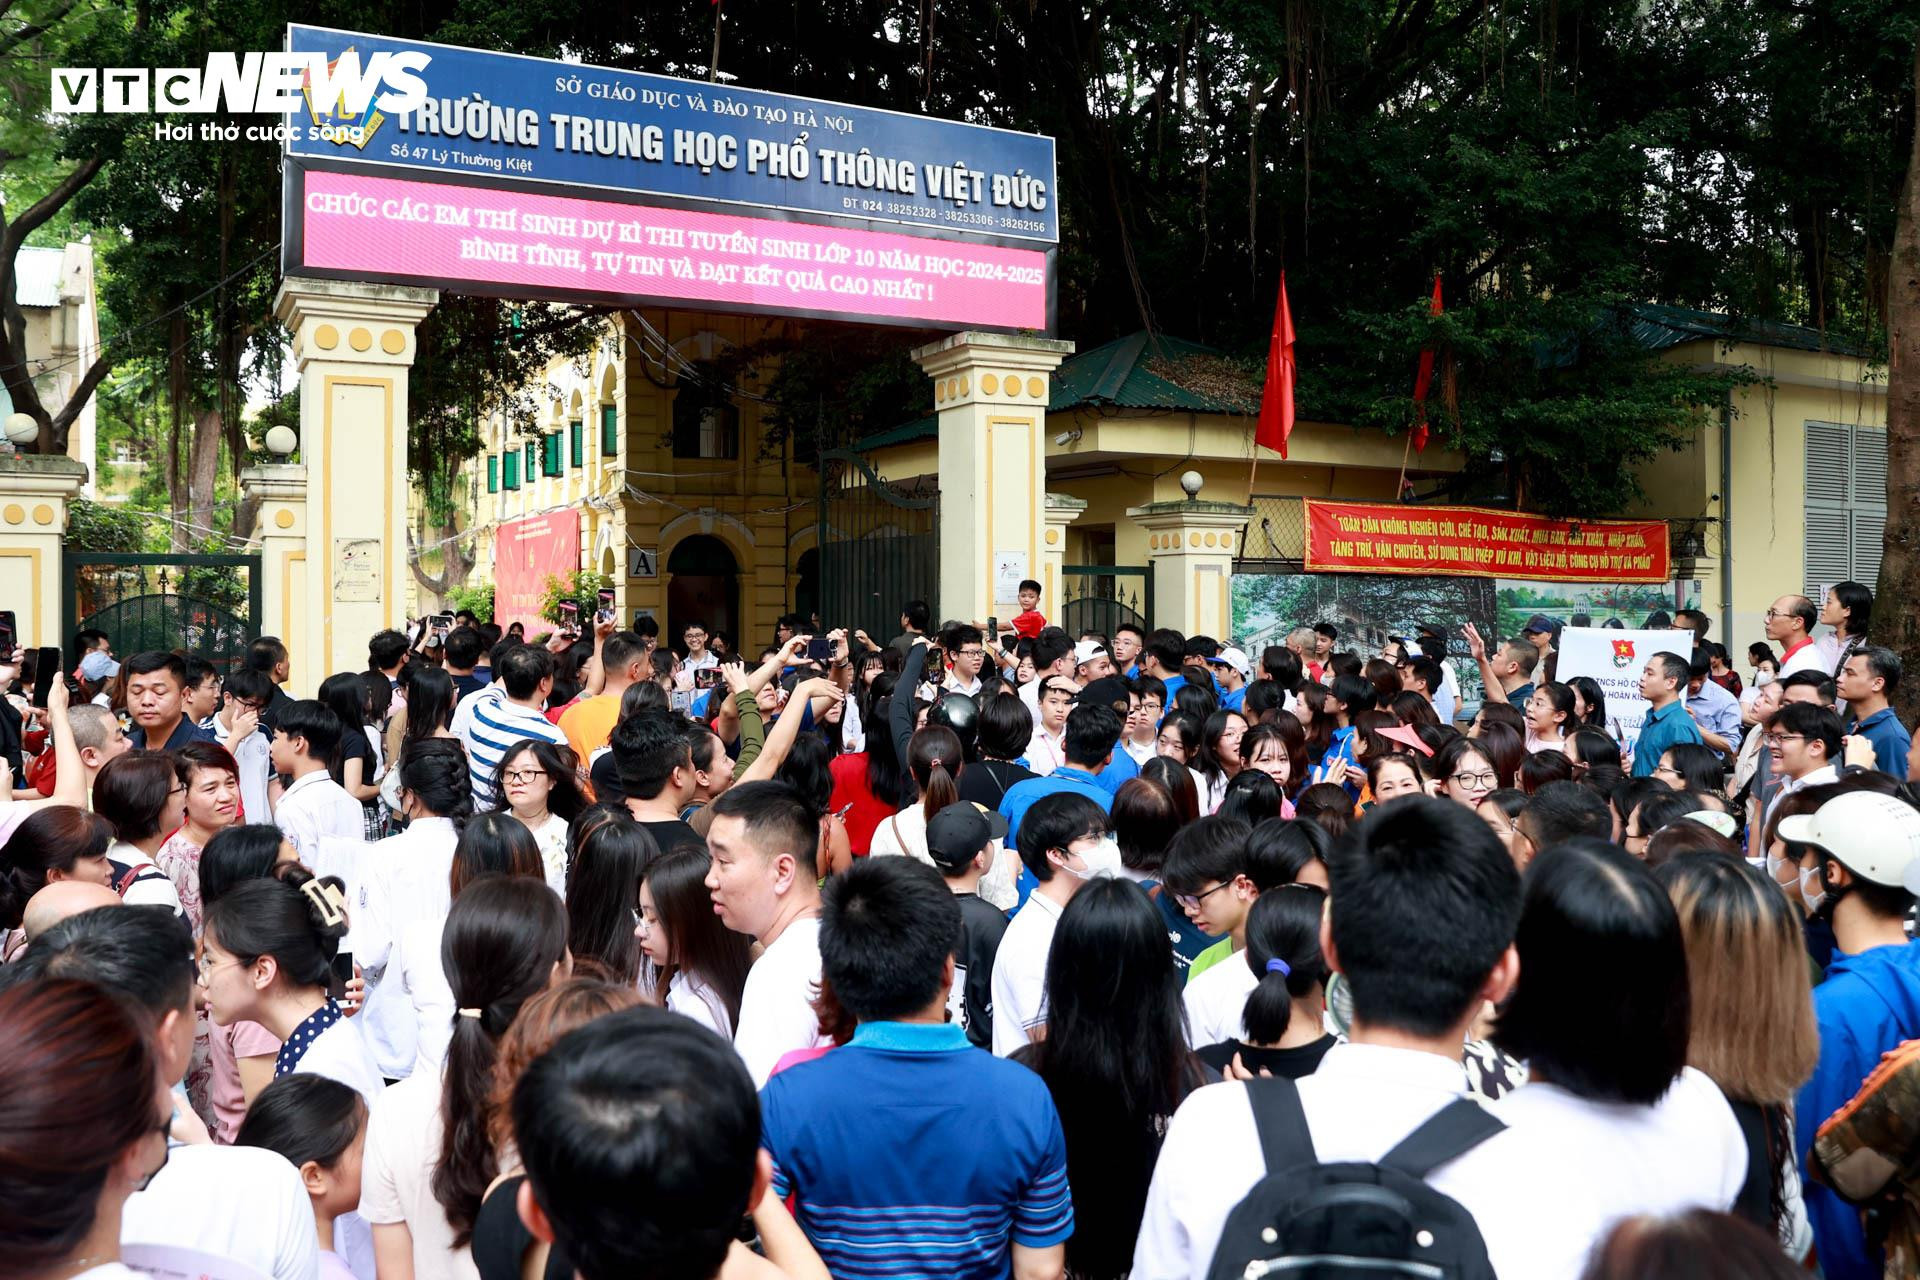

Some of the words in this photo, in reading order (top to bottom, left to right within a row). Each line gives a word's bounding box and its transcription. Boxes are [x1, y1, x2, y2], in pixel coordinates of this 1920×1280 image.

[555, 75, 582, 94] SỞ
[586, 81, 636, 102] GIÁO
[641, 88, 681, 110] DỤC
[687, 92, 707, 112] VÀ
[712, 97, 749, 118] ĐÀO
[753, 105, 787, 125] TẠO
[792, 108, 818, 128] HÀ
[823, 113, 855, 136] NỘI
[390, 143, 409, 159] Số
[412, 147, 427, 160] 47
[432, 148, 449, 165] Lý
[451, 151, 502, 171] Thường
[506, 157, 533, 174] Kiệt
[550, 112, 664, 163] TRUNG
[673, 128, 739, 175] HỌC
[746, 131, 810, 180] PHỔ
[818, 147, 917, 195] THÔNG
[923, 160, 986, 208] VIỆT
[990, 168, 1047, 212] ĐỨC
[843, 197, 858, 209] ĐT
[862, 199, 883, 212] 024
[887, 202, 937, 219] 38252328
[944, 210, 993, 226] 38253306
[1000, 216, 1045, 233] 38262156
[307, 192, 378, 217] CHÚC
[381, 197, 430, 223] CÁC
[433, 204, 471, 227] EM
[474, 207, 517, 231] THÍ
[520, 213, 577, 238] SINH
[581, 218, 614, 244] DỰ
[618, 217, 642, 244] KÌ
[645, 226, 685, 249] THI
[688, 229, 758, 256] TUYỂN
[761, 237, 810, 261] SINH
[855, 249, 875, 267] 10
[878, 248, 921, 272] NĂM
[924, 256, 964, 279] HỌC
[966, 260, 1043, 285] 2024-2025
[459, 236, 519, 263] BÌNH
[522, 242, 587, 273] TĨNH,
[592, 251, 624, 276] TỰ
[626, 255, 664, 277] TIN
[668, 256, 696, 280] VÀ
[699, 261, 740, 285] ĐẠT
[743, 263, 783, 287] KẾT
[785, 270, 827, 292] QUẢ
[830, 274, 869, 295] CAO
[872, 277, 925, 300] NHẤT
[1380, 516, 1408, 535] KHÔNG
[1409, 518, 1438, 537] NGHIÊN
[1458, 518, 1473, 538] CHẾ
[1532, 528, 1549, 545] MUA
[633, 552, 653, 575] A
[1375, 539, 1392, 562] VẬN
[1475, 545, 1494, 564] PHÉP
[1569, 551, 1588, 569] CÔNG
